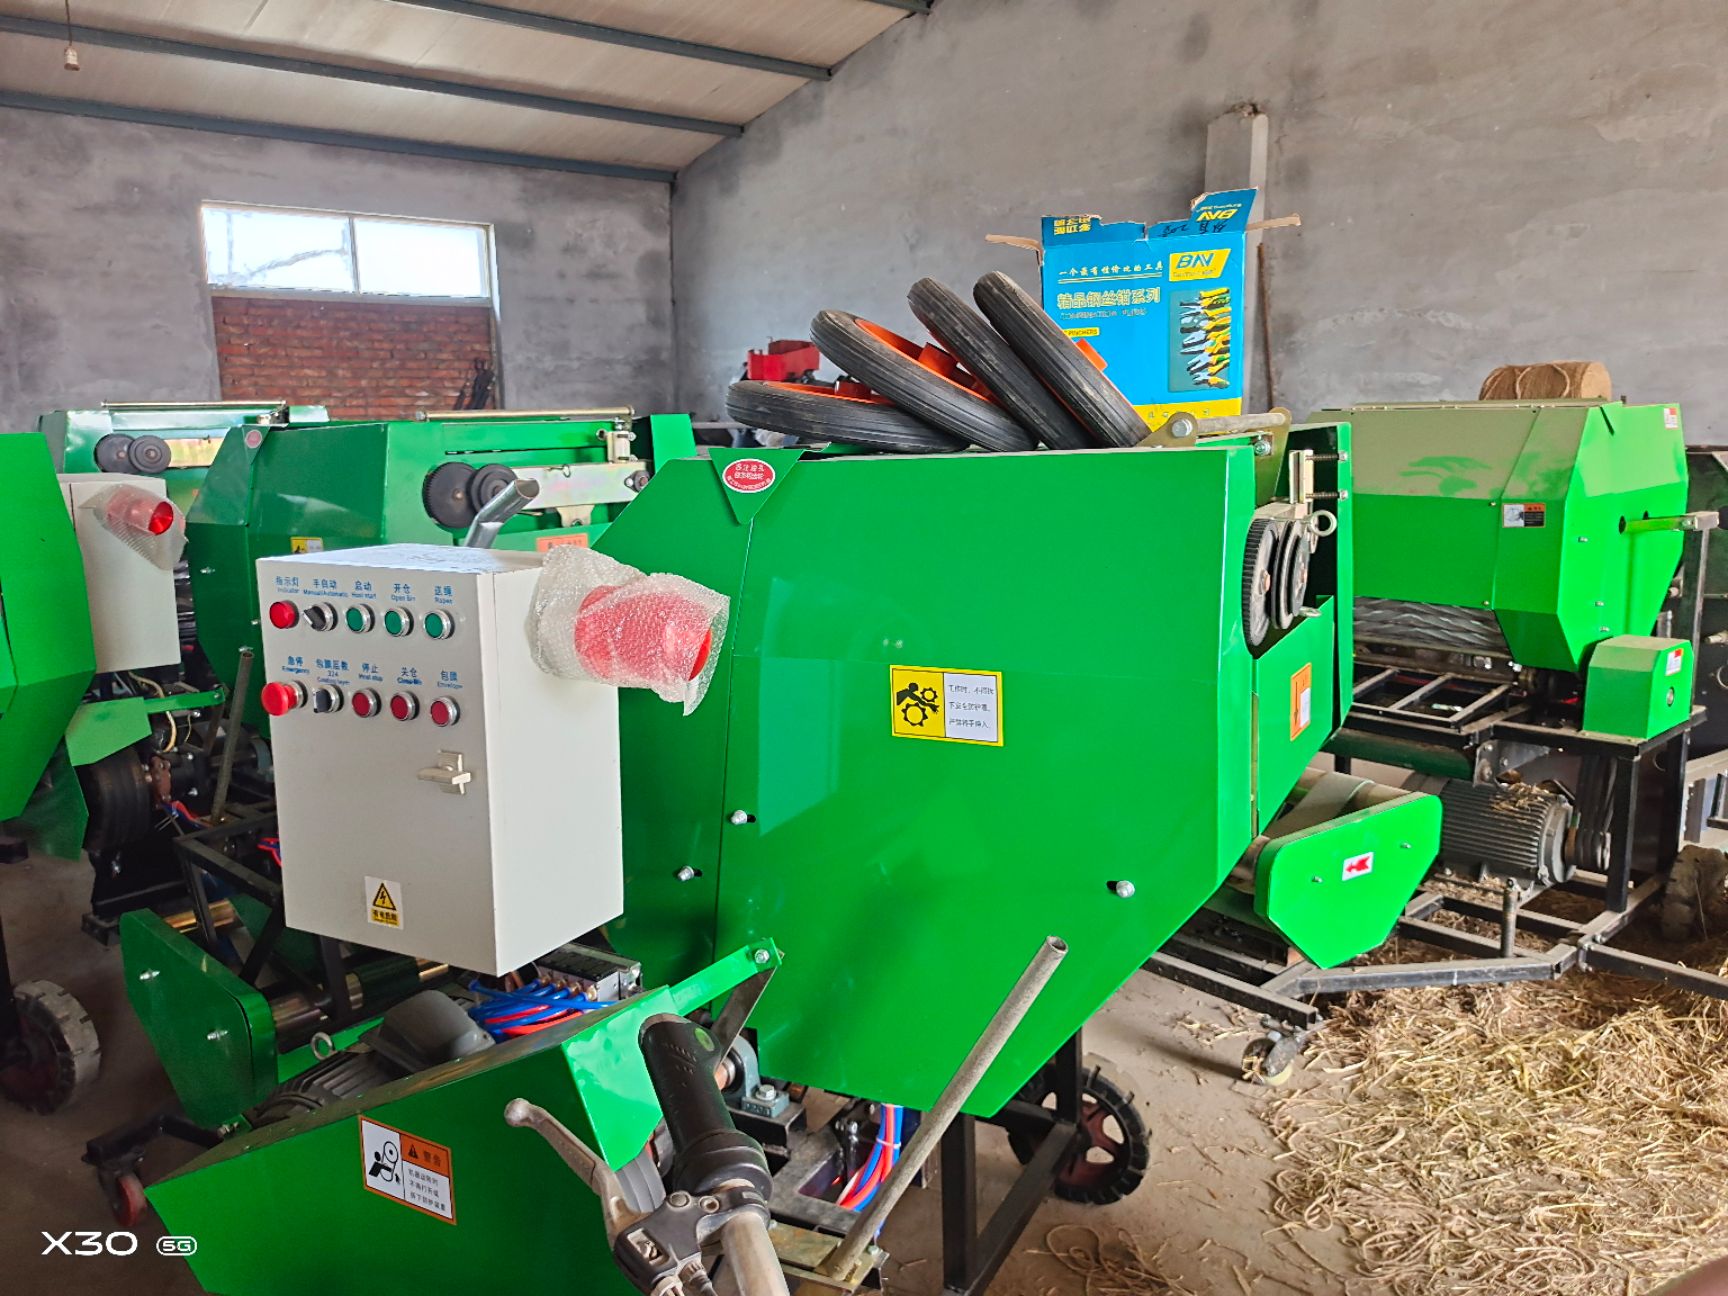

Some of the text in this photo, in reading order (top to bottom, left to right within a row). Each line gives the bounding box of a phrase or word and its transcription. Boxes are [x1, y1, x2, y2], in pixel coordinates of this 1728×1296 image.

[1059, 260, 1163, 276] 一个最有性价比的工具
[1057, 287, 1161, 310] 精品钢丝钳系列
[275, 575, 299, 587] 指示灯
[313, 578, 337, 589] 手自动
[354, 580, 372, 592] 启动
[394, 583, 410, 594] 开仓
[287, 655, 303, 666] 急停
[361, 663, 378, 674] 停止
[400, 666, 417, 677] 关仓
